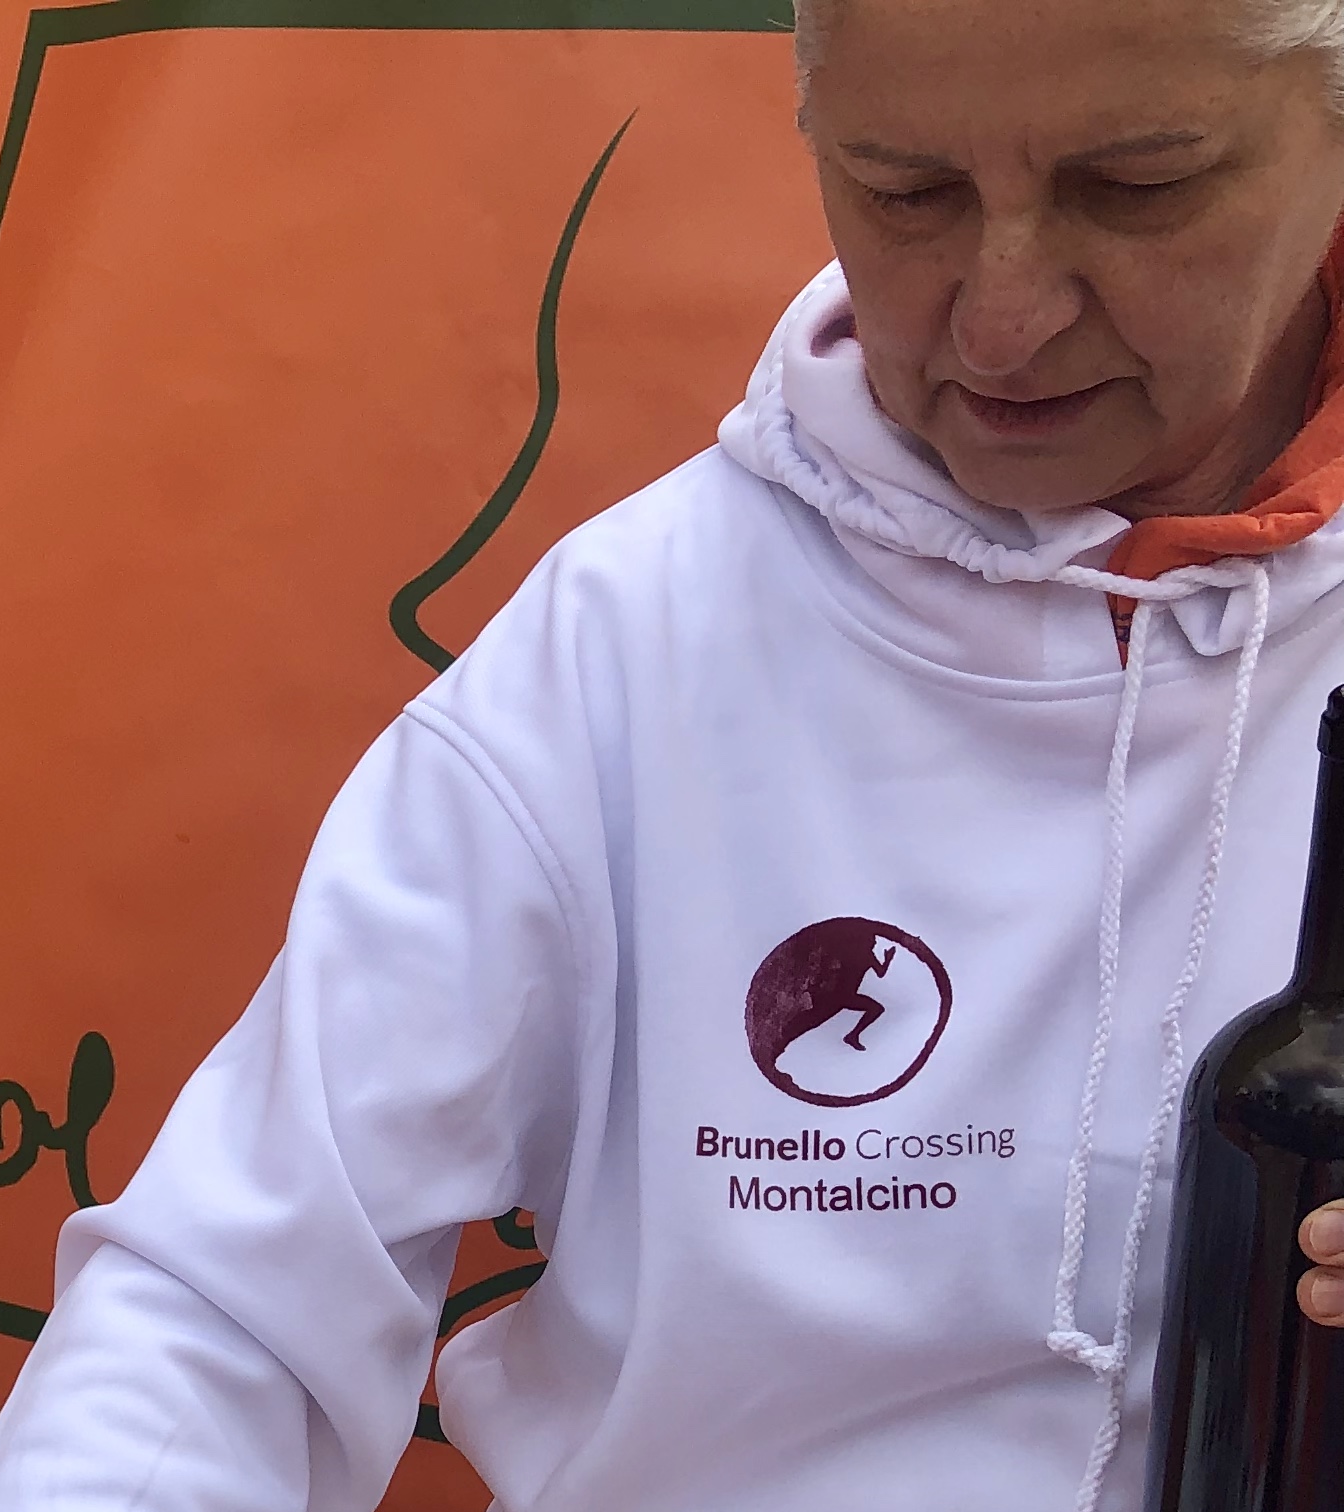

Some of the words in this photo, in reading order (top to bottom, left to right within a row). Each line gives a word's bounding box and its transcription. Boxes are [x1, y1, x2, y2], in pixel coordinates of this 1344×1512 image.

[696, 1126, 846, 1160] Brunello
[856, 1123, 1016, 1159] Crossing
[729, 1175, 957, 1212] Montalcino
